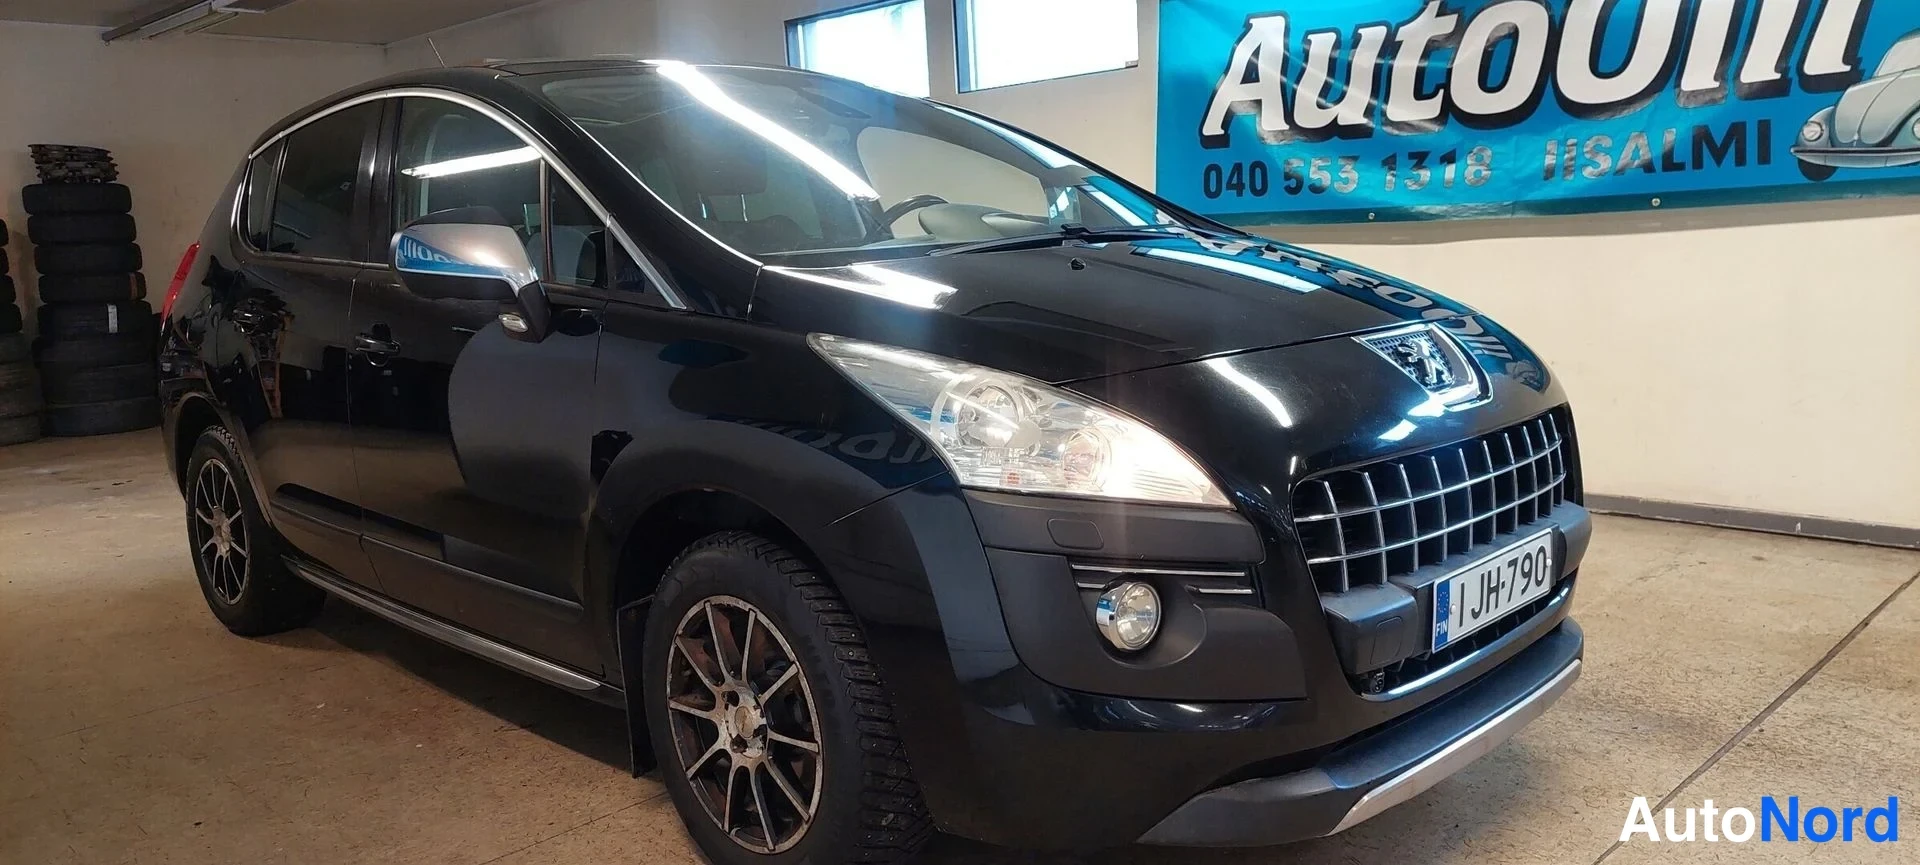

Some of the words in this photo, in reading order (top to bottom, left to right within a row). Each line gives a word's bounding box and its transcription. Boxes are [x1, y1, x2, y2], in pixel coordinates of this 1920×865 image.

[1203, 160, 1269, 199] 040
[1283, 155, 1361, 195] 553
[1381, 146, 1494, 192] 1318
[1542, 119, 1772, 181] IISALMI
[1435, 619, 1448, 637] FIN
